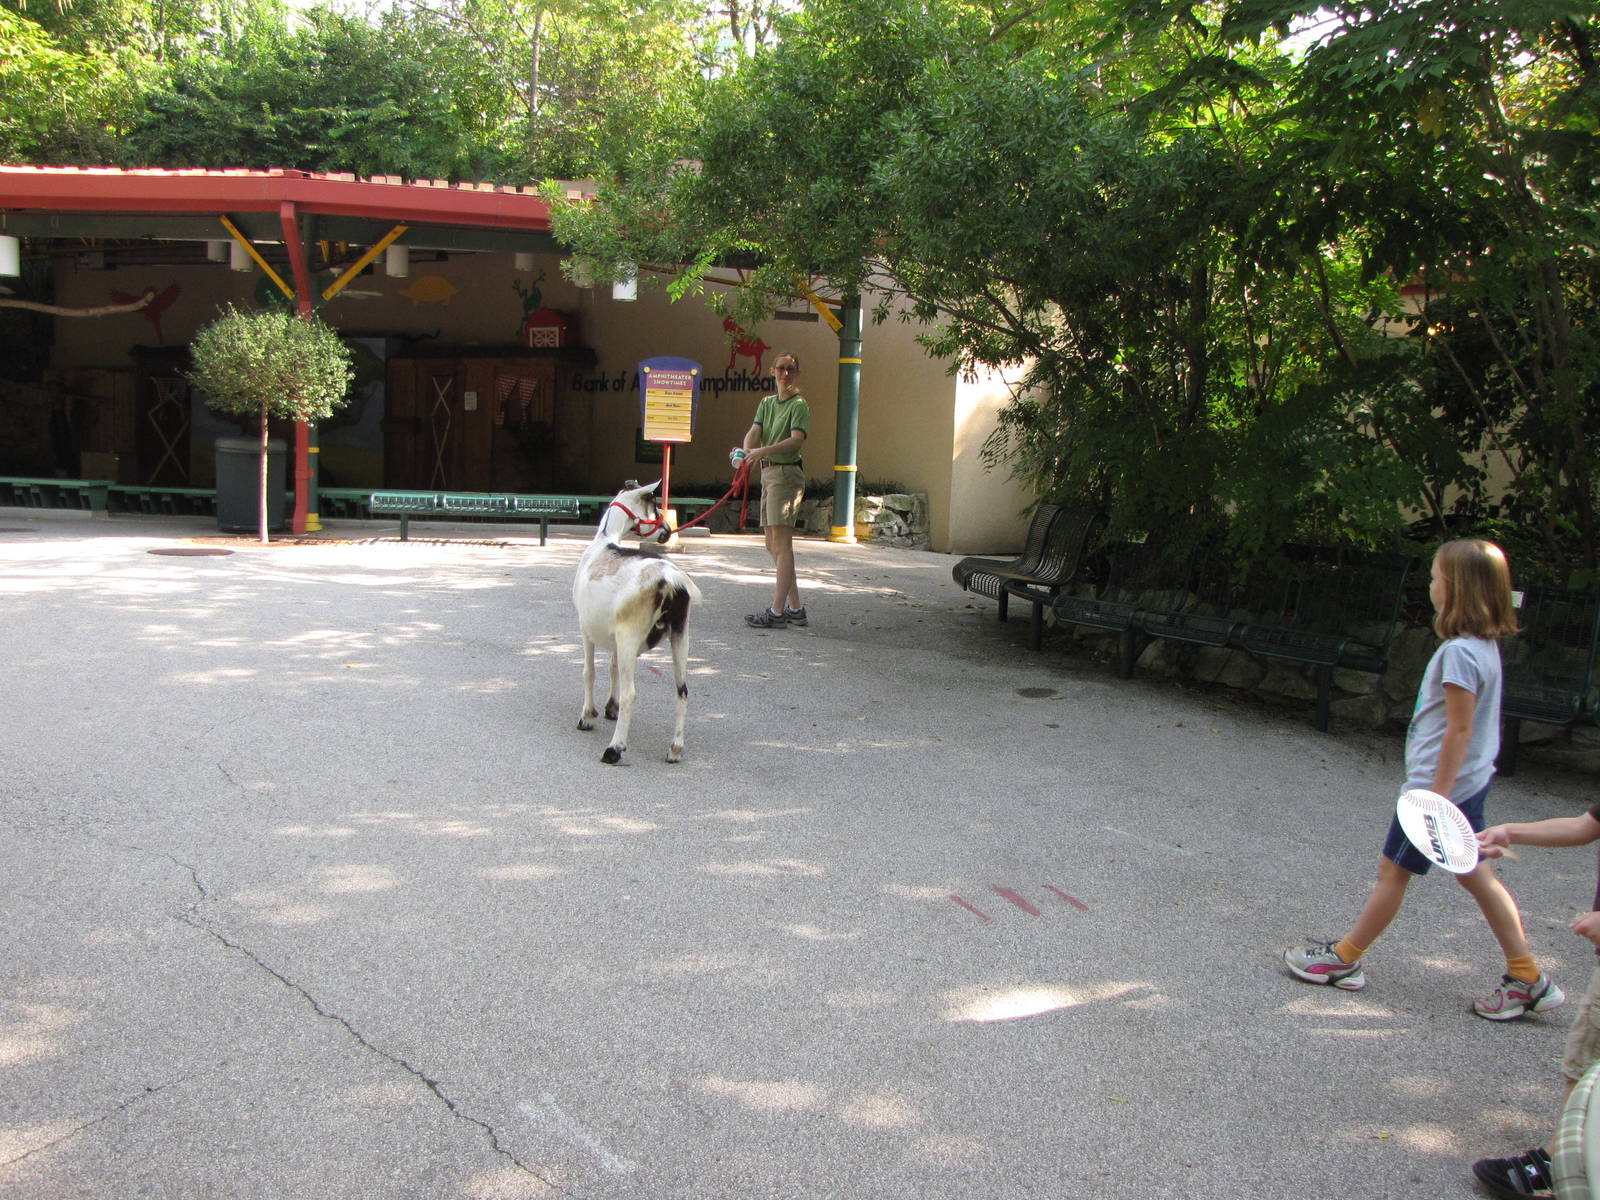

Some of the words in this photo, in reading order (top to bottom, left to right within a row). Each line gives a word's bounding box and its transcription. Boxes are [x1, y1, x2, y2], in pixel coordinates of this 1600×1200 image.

[572, 371, 609, 392] Bank
[613, 370, 626, 392] of
[648, 373, 692, 381] AMPHITHEATER
